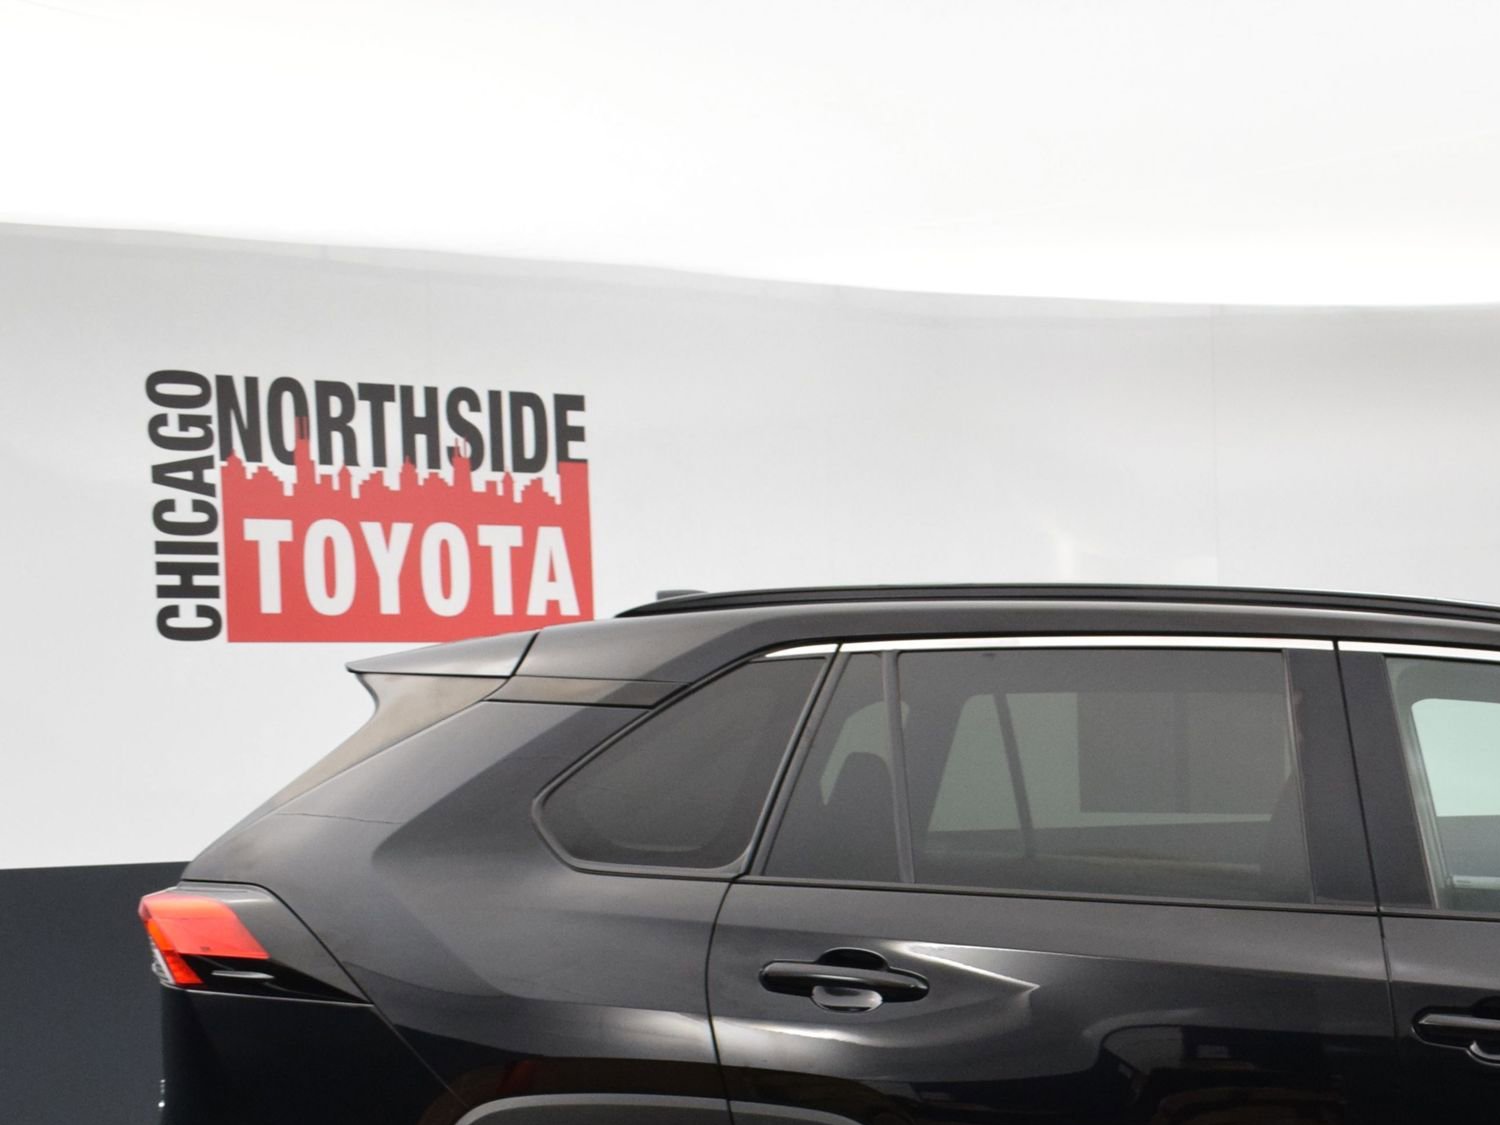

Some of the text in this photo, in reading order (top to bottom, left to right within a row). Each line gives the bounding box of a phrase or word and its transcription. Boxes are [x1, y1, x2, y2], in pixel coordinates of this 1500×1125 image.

[215, 374, 587, 474] NORTHSIDE
[146, 369, 222, 642] CHICAGO
[243, 518, 580, 617] TOYOTA
